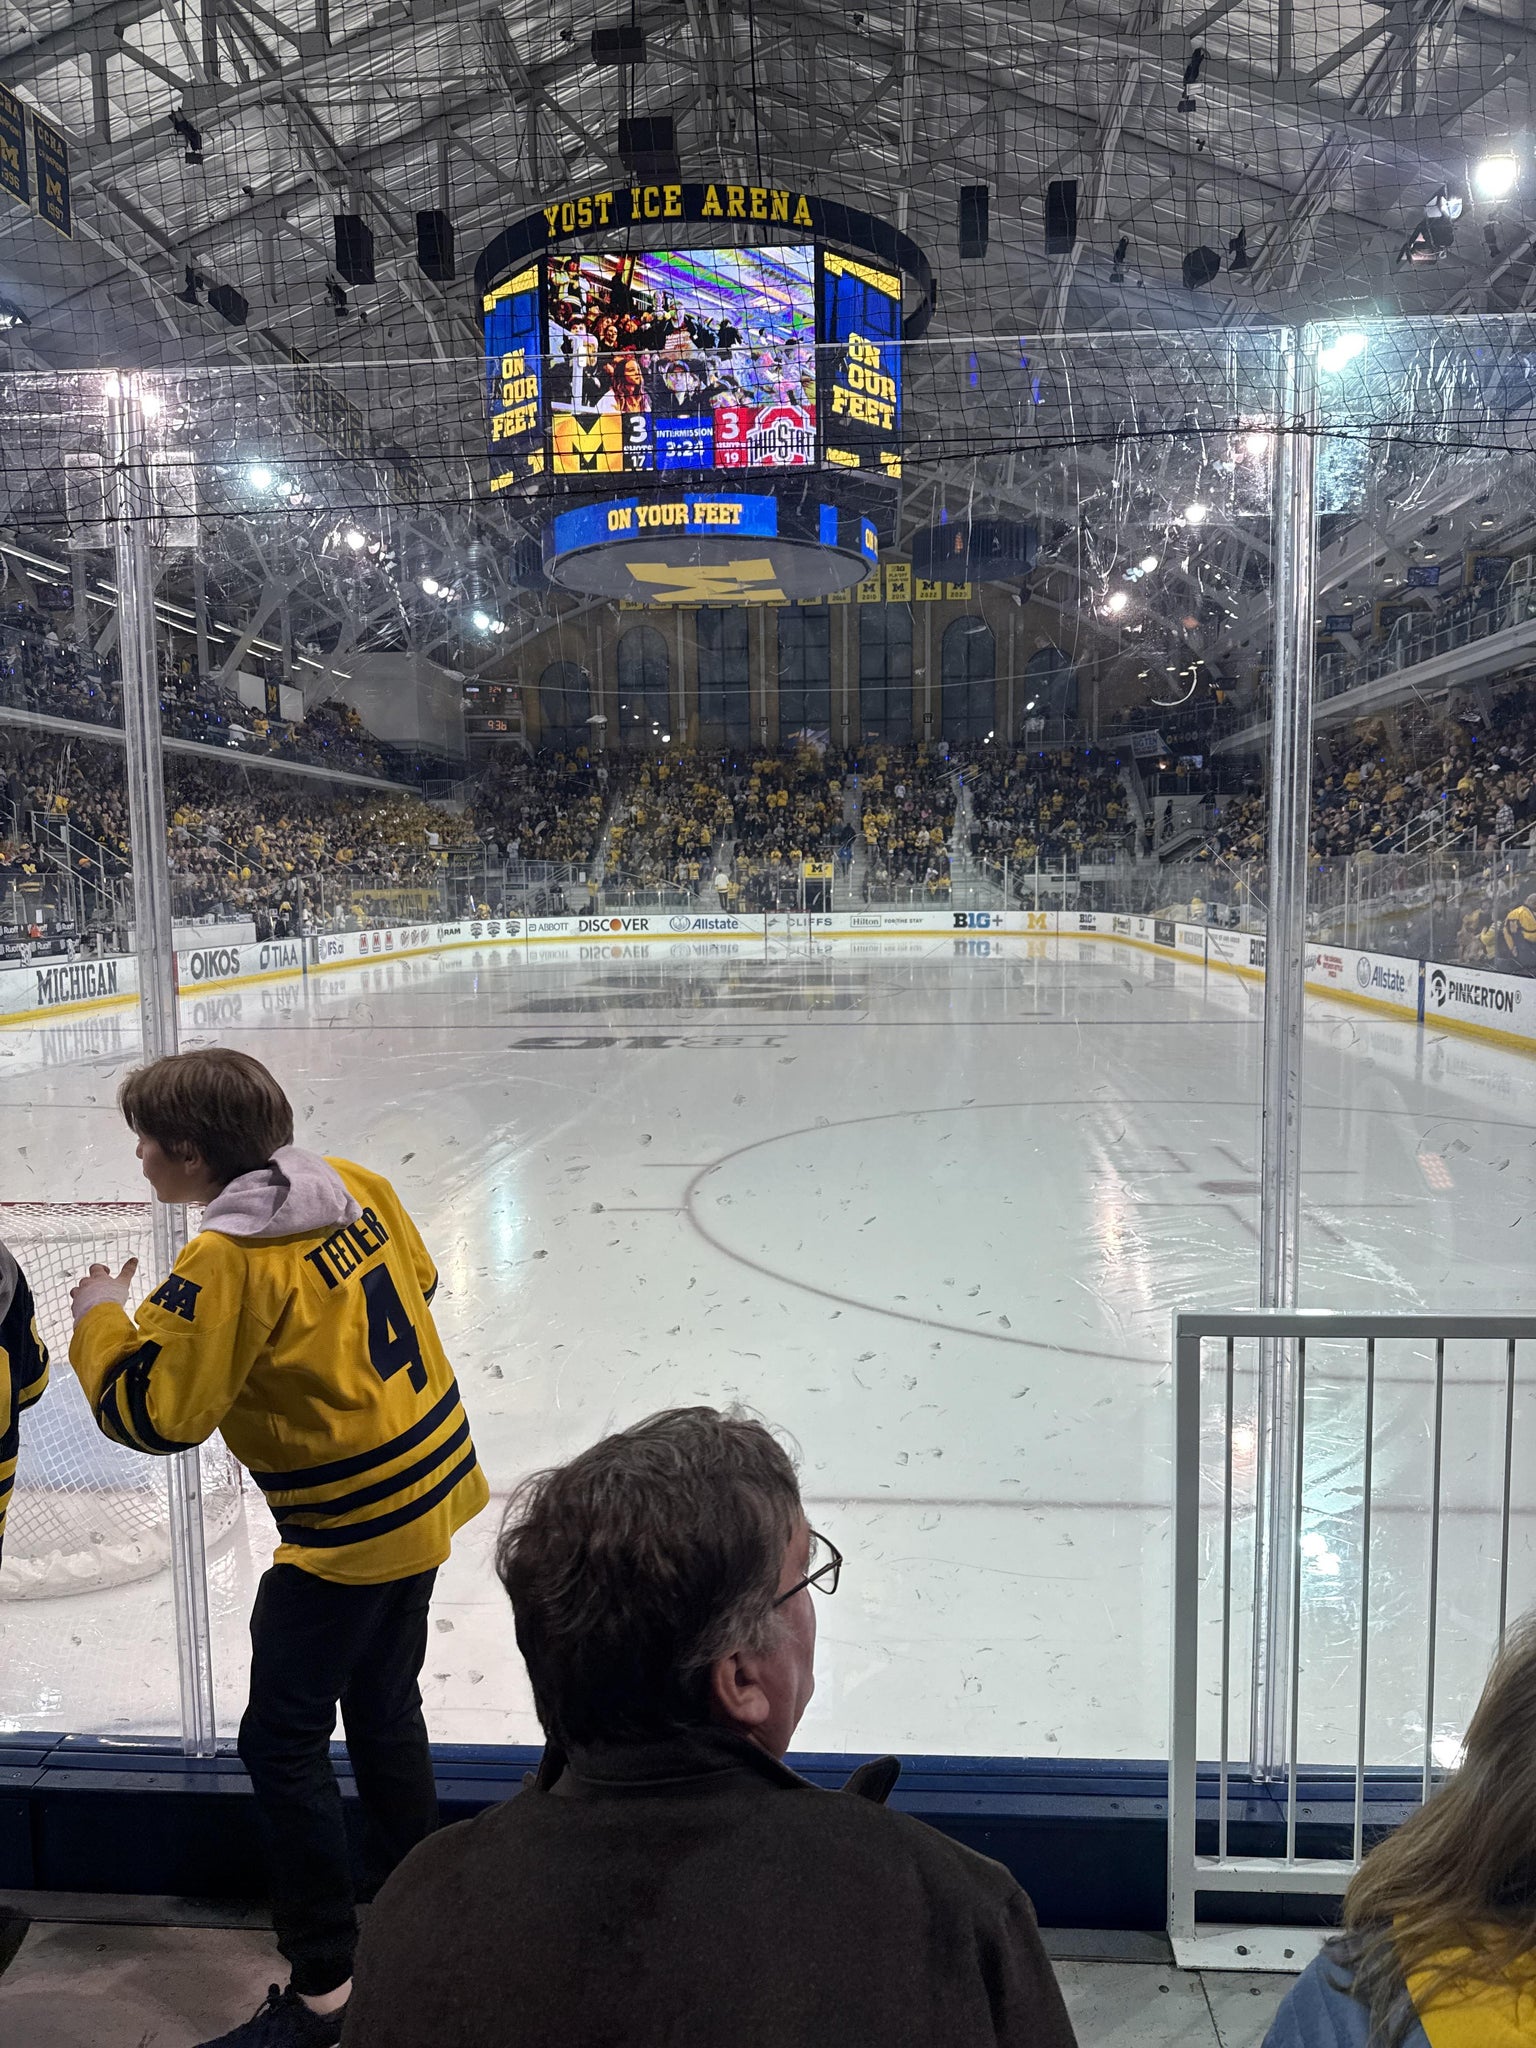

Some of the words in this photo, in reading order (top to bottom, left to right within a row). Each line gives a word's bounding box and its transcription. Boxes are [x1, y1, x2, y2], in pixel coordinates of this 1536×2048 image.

[0, 91, 20, 122] CHA
[37, 125, 64, 158] CCHA
[46, 173, 63, 205] M
[543, 192, 613, 237] YOST
[631, 185, 682, 219] ICE
[701, 184, 814, 227] ARENA
[502, 348, 525, 380] ON
[848, 332, 881, 369] ON
[832, 385, 895, 430] FEET
[492, 402, 537, 442] FEET
[629, 416, 648, 443] 3
[656, 428, 714, 438] INTERMISSION
[721, 412, 740, 440] 3
[553, 413, 622, 473] M
[666, 440, 705, 457] 3:24
[778, 424, 814, 459] STAT
[631, 456, 646, 467] 17
[724, 452, 739, 464] 19
[608, 508, 632, 531] ON
[634, 503, 690, 528] YOUR
[694, 503, 742, 524] FEET
[863, 583, 876, 592] M
[892, 583, 905, 592] M
[922, 581, 935, 590] M
[811, 864, 823, 873] M
[444, 928, 461, 937] RAM
[538, 922, 569, 932] ABBOTT
[579, 918, 650, 932] DISCOVER
[691, 916, 739, 930] Allstate
[786, 918, 832, 927] CLIFFS
[852, 915, 879, 925] Hilton
[1027, 913, 1047, 930] M
[191, 948, 240, 980] OIKOS
[271, 944, 298, 967] TIAA
[36, 961, 118, 1005] MICHIGAN
[1370, 965, 1405, 993] Allstate
[303, 1207, 389, 1290] TEETER
[360, 1262, 428, 1395] 4
